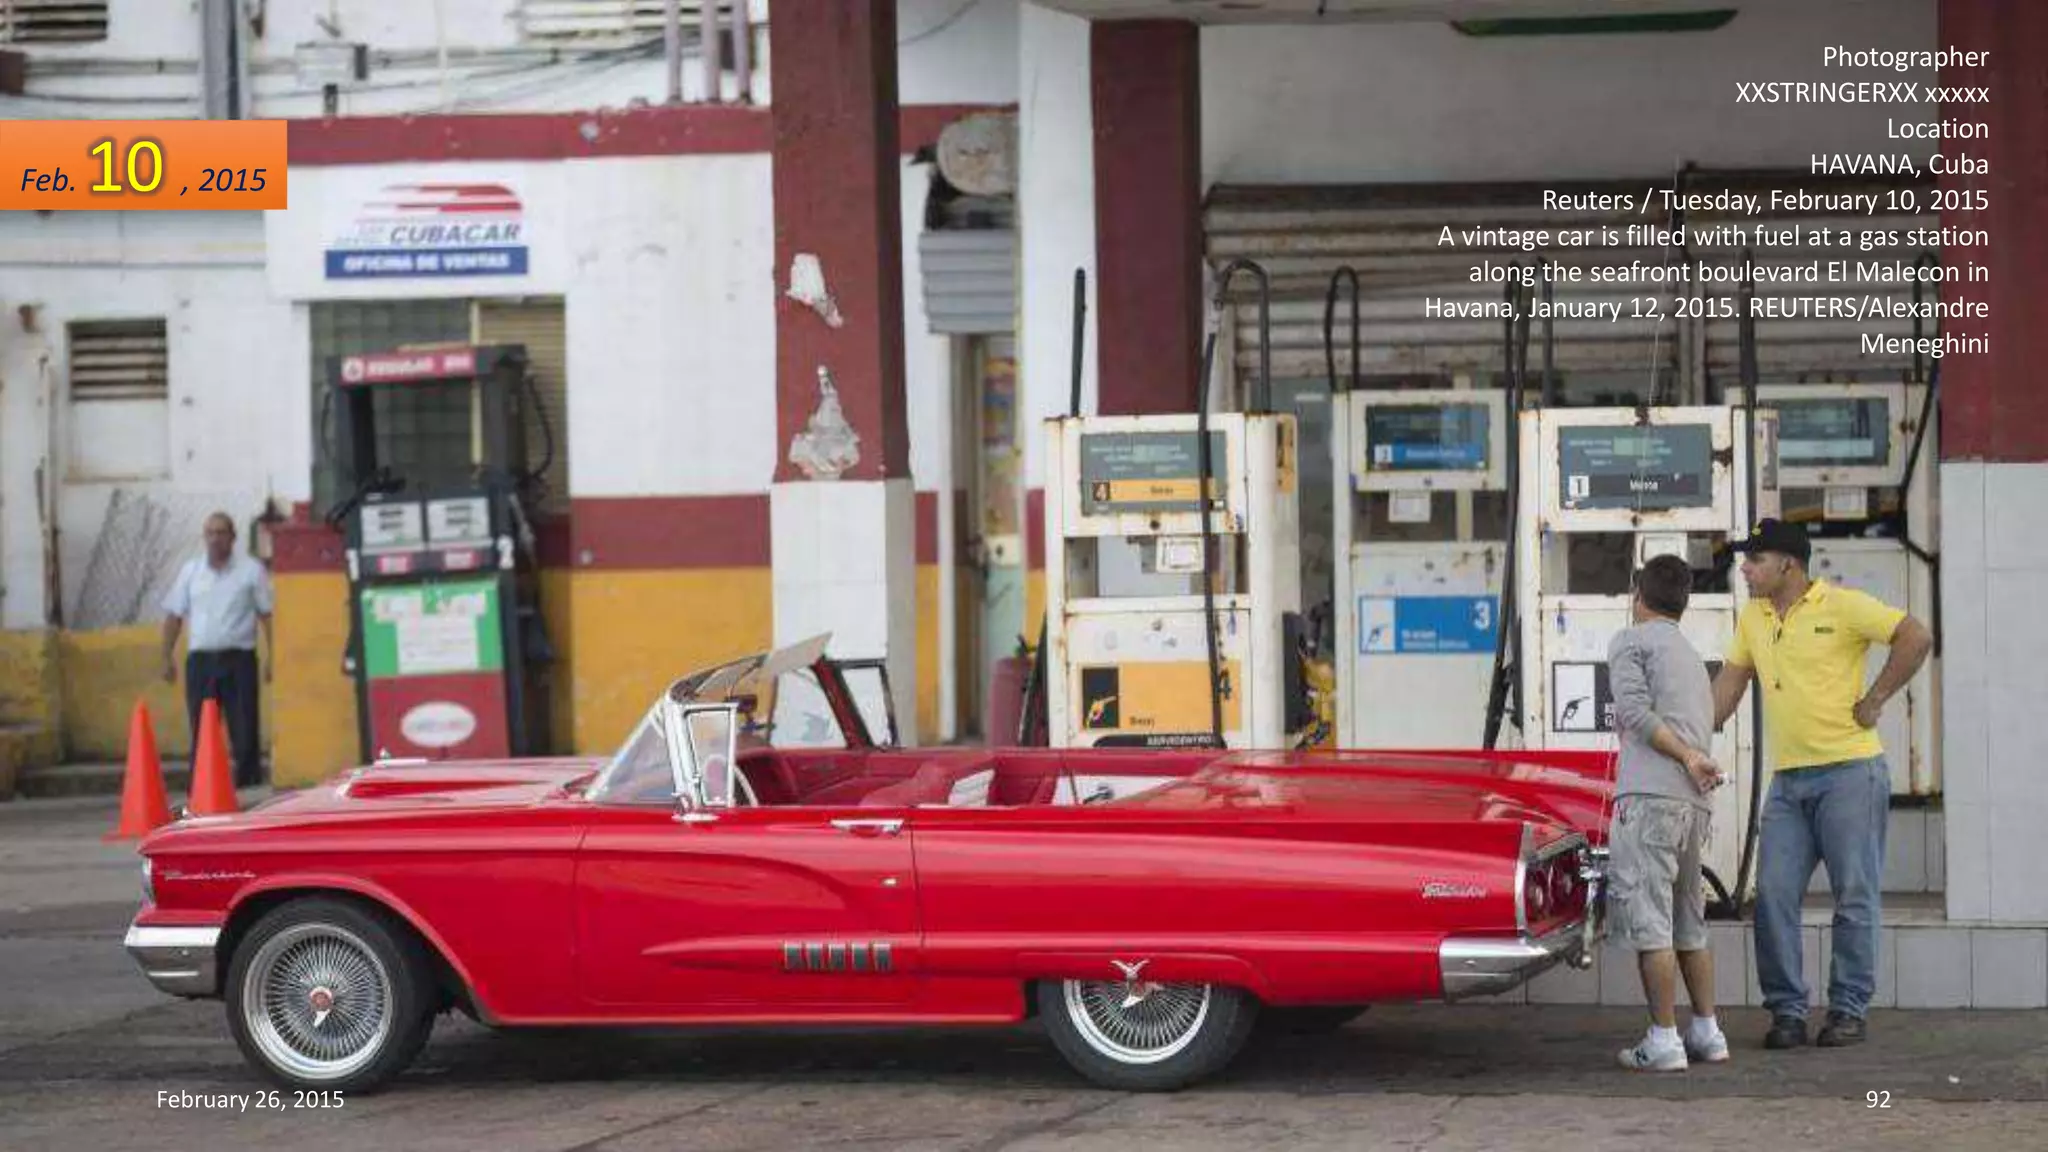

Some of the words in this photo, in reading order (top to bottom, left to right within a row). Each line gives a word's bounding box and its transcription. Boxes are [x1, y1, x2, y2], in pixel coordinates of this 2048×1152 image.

[390, 223, 520, 244] CUBACAR
[343, 254, 413, 272] OFICINA
[417, 253, 439, 271] DE
[442, 252, 510, 270] VENTAS
[1472, 599, 1491, 631] 3
